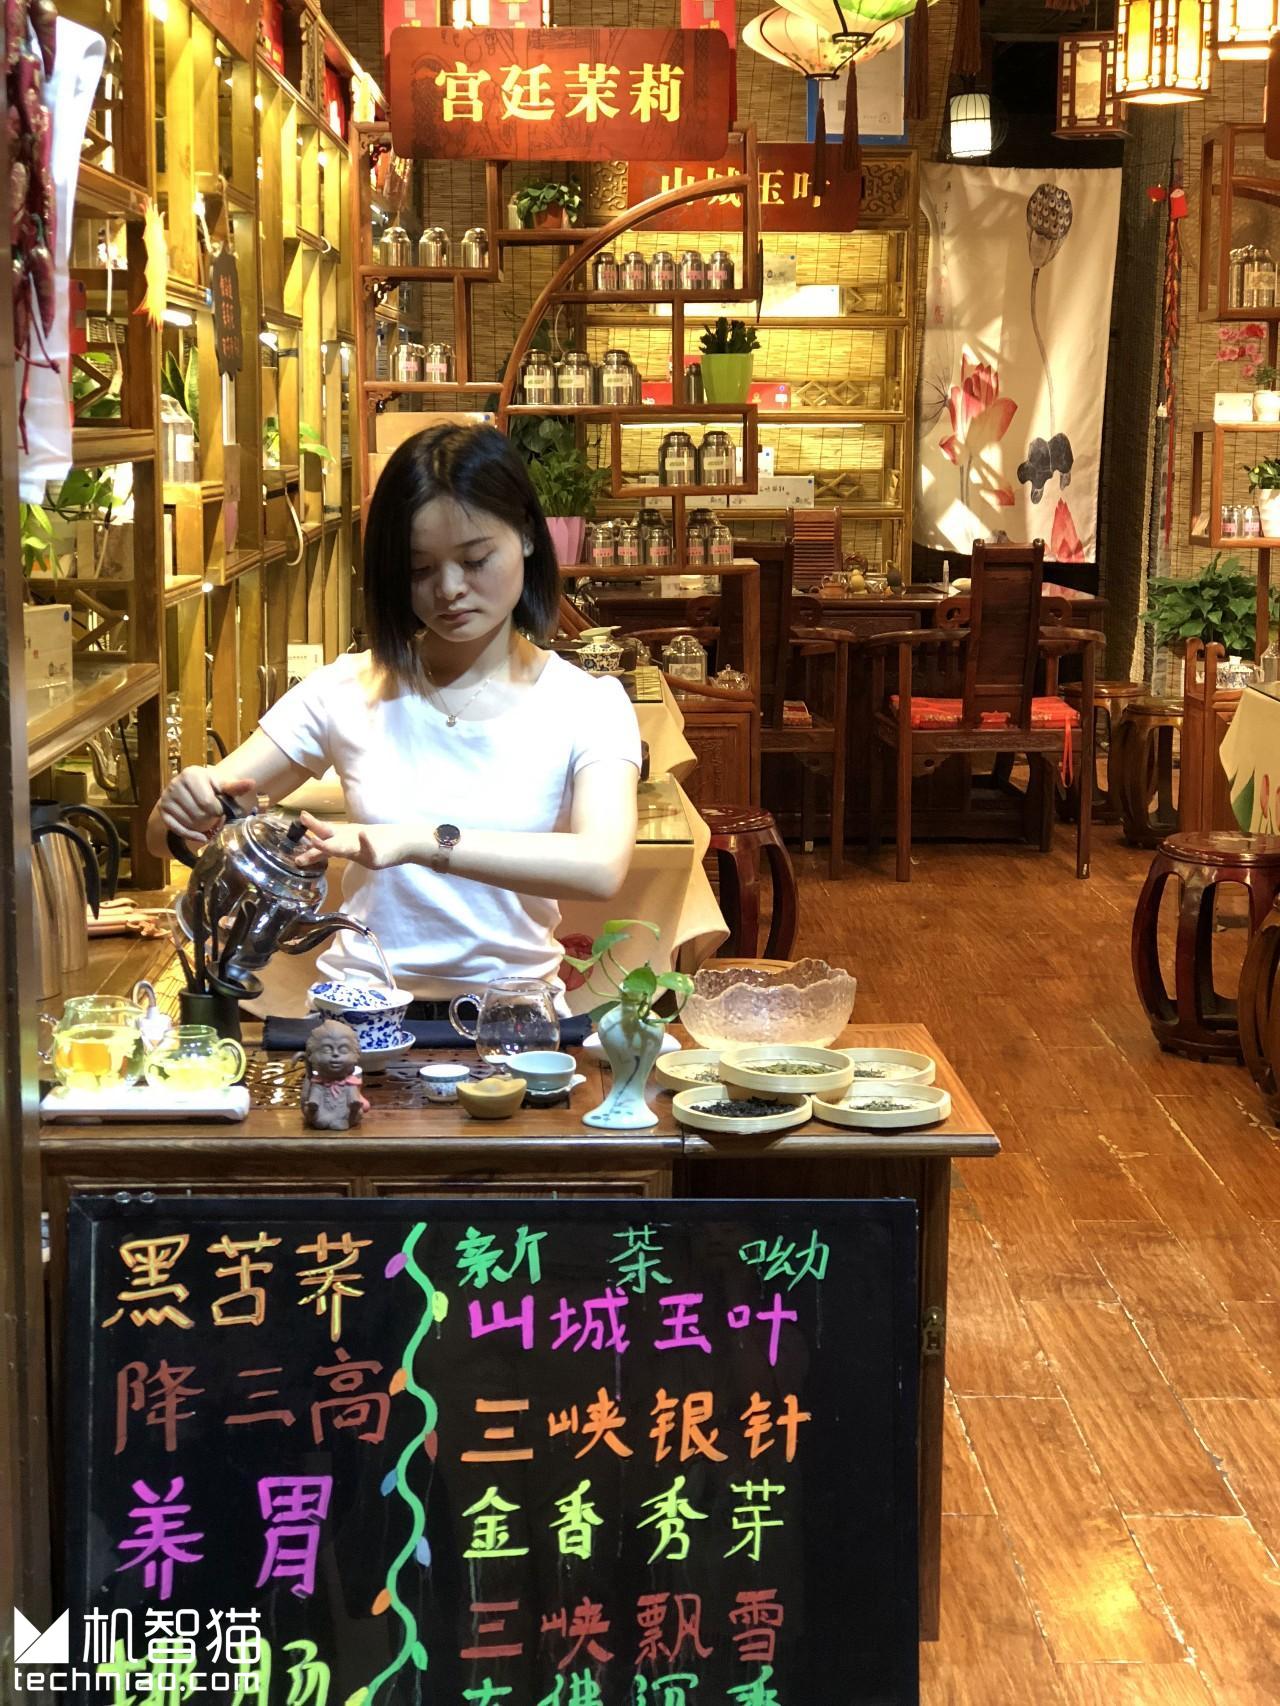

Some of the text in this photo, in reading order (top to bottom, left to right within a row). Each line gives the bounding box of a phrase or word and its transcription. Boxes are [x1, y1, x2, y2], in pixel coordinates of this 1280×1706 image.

[434, 61, 686, 123] 宫廷茉莉
[101, 1231, 374, 1342] 黑苦荞
[455, 1224, 830, 1294] 新茶呦
[467, 1287, 798, 1367] 山城玉叶
[114, 1347, 391, 1455] 降三高
[460, 1387, 812, 1463] 三峡银针
[115, 1475, 333, 1601] 养胃
[462, 1475, 786, 1565] 金香秀芽
[460, 1588, 784, 1669] 三峡飘雪
